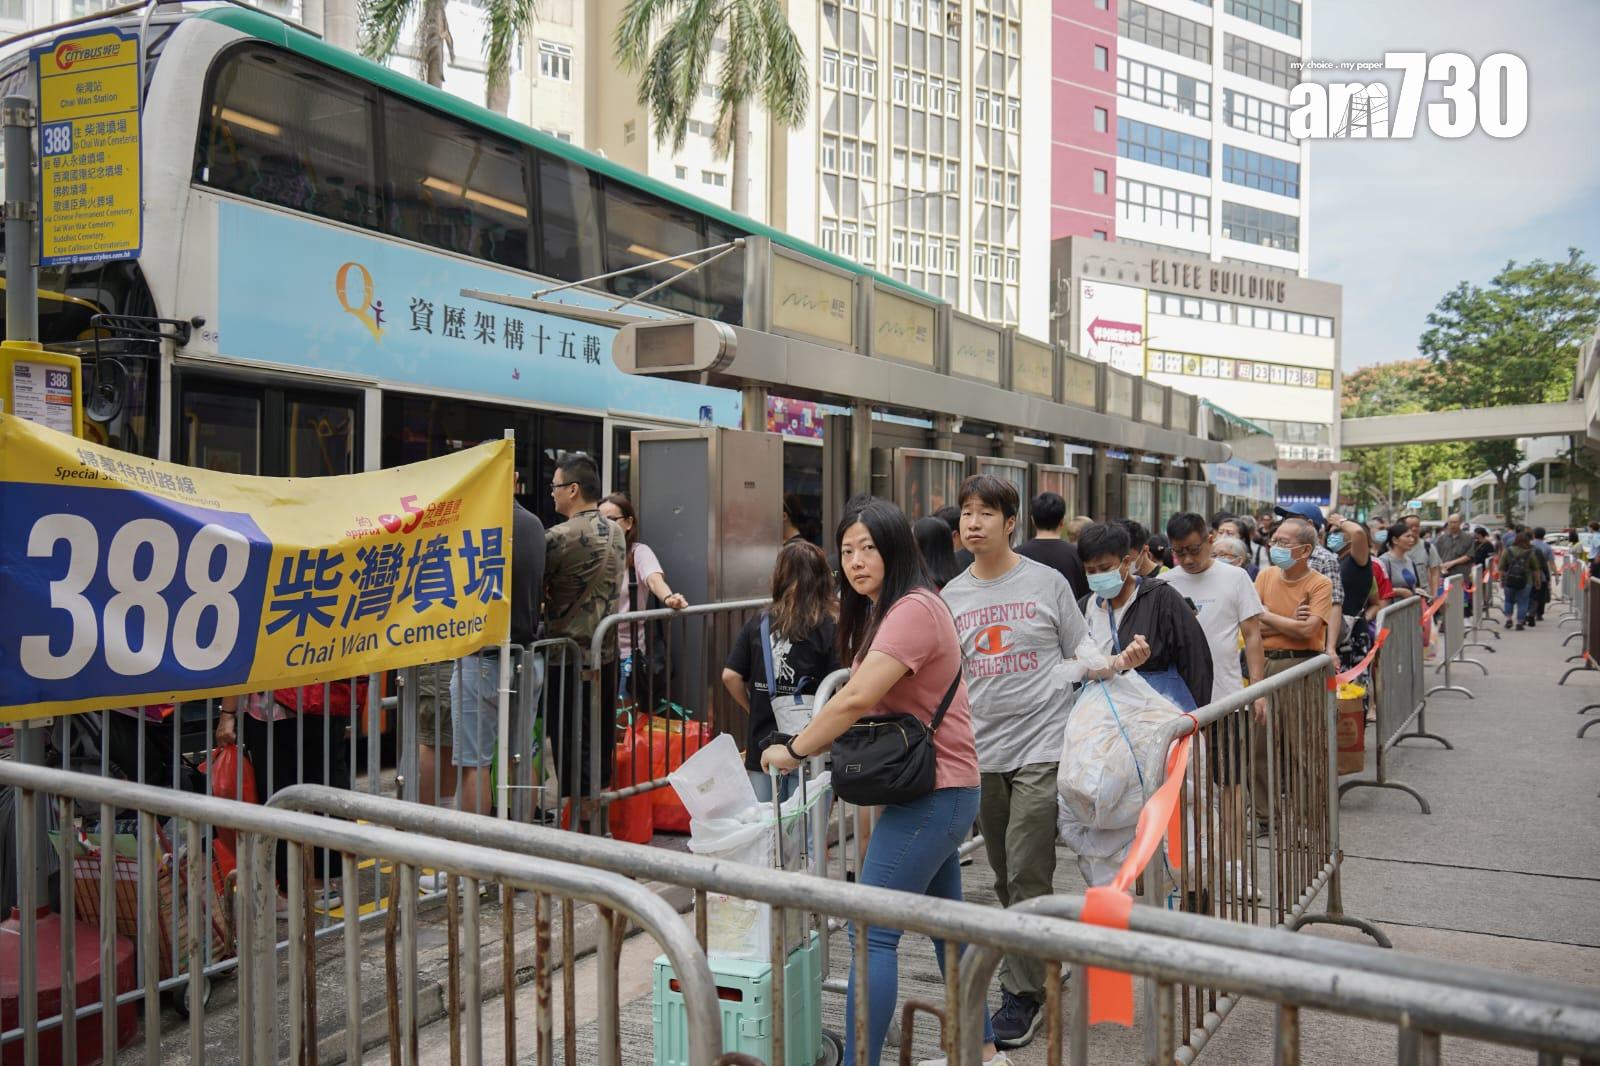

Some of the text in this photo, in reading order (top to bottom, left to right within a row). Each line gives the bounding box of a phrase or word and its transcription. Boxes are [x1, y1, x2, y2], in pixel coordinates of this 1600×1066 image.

[64, 47, 103, 62] CITYBUS
[77, 96, 92, 105] Wan
[93, 94, 118, 103] Station
[44, 126, 71, 154] 388
[1151, 258, 1287, 304] ELTEE BUILDING
[408, 296, 602, 366] 資歷架構十五載
[50, 372, 68, 388] 388
[54, 465, 99, 482] Special
[400, 495, 424, 535] 5
[20, 513, 251, 680] 388
[264, 527, 506, 638] 柴灣墳場
[956, 601, 1037, 633] AUTHENTIC
[285, 638, 336, 668] Chai
[340, 631, 379, 657] Wan
